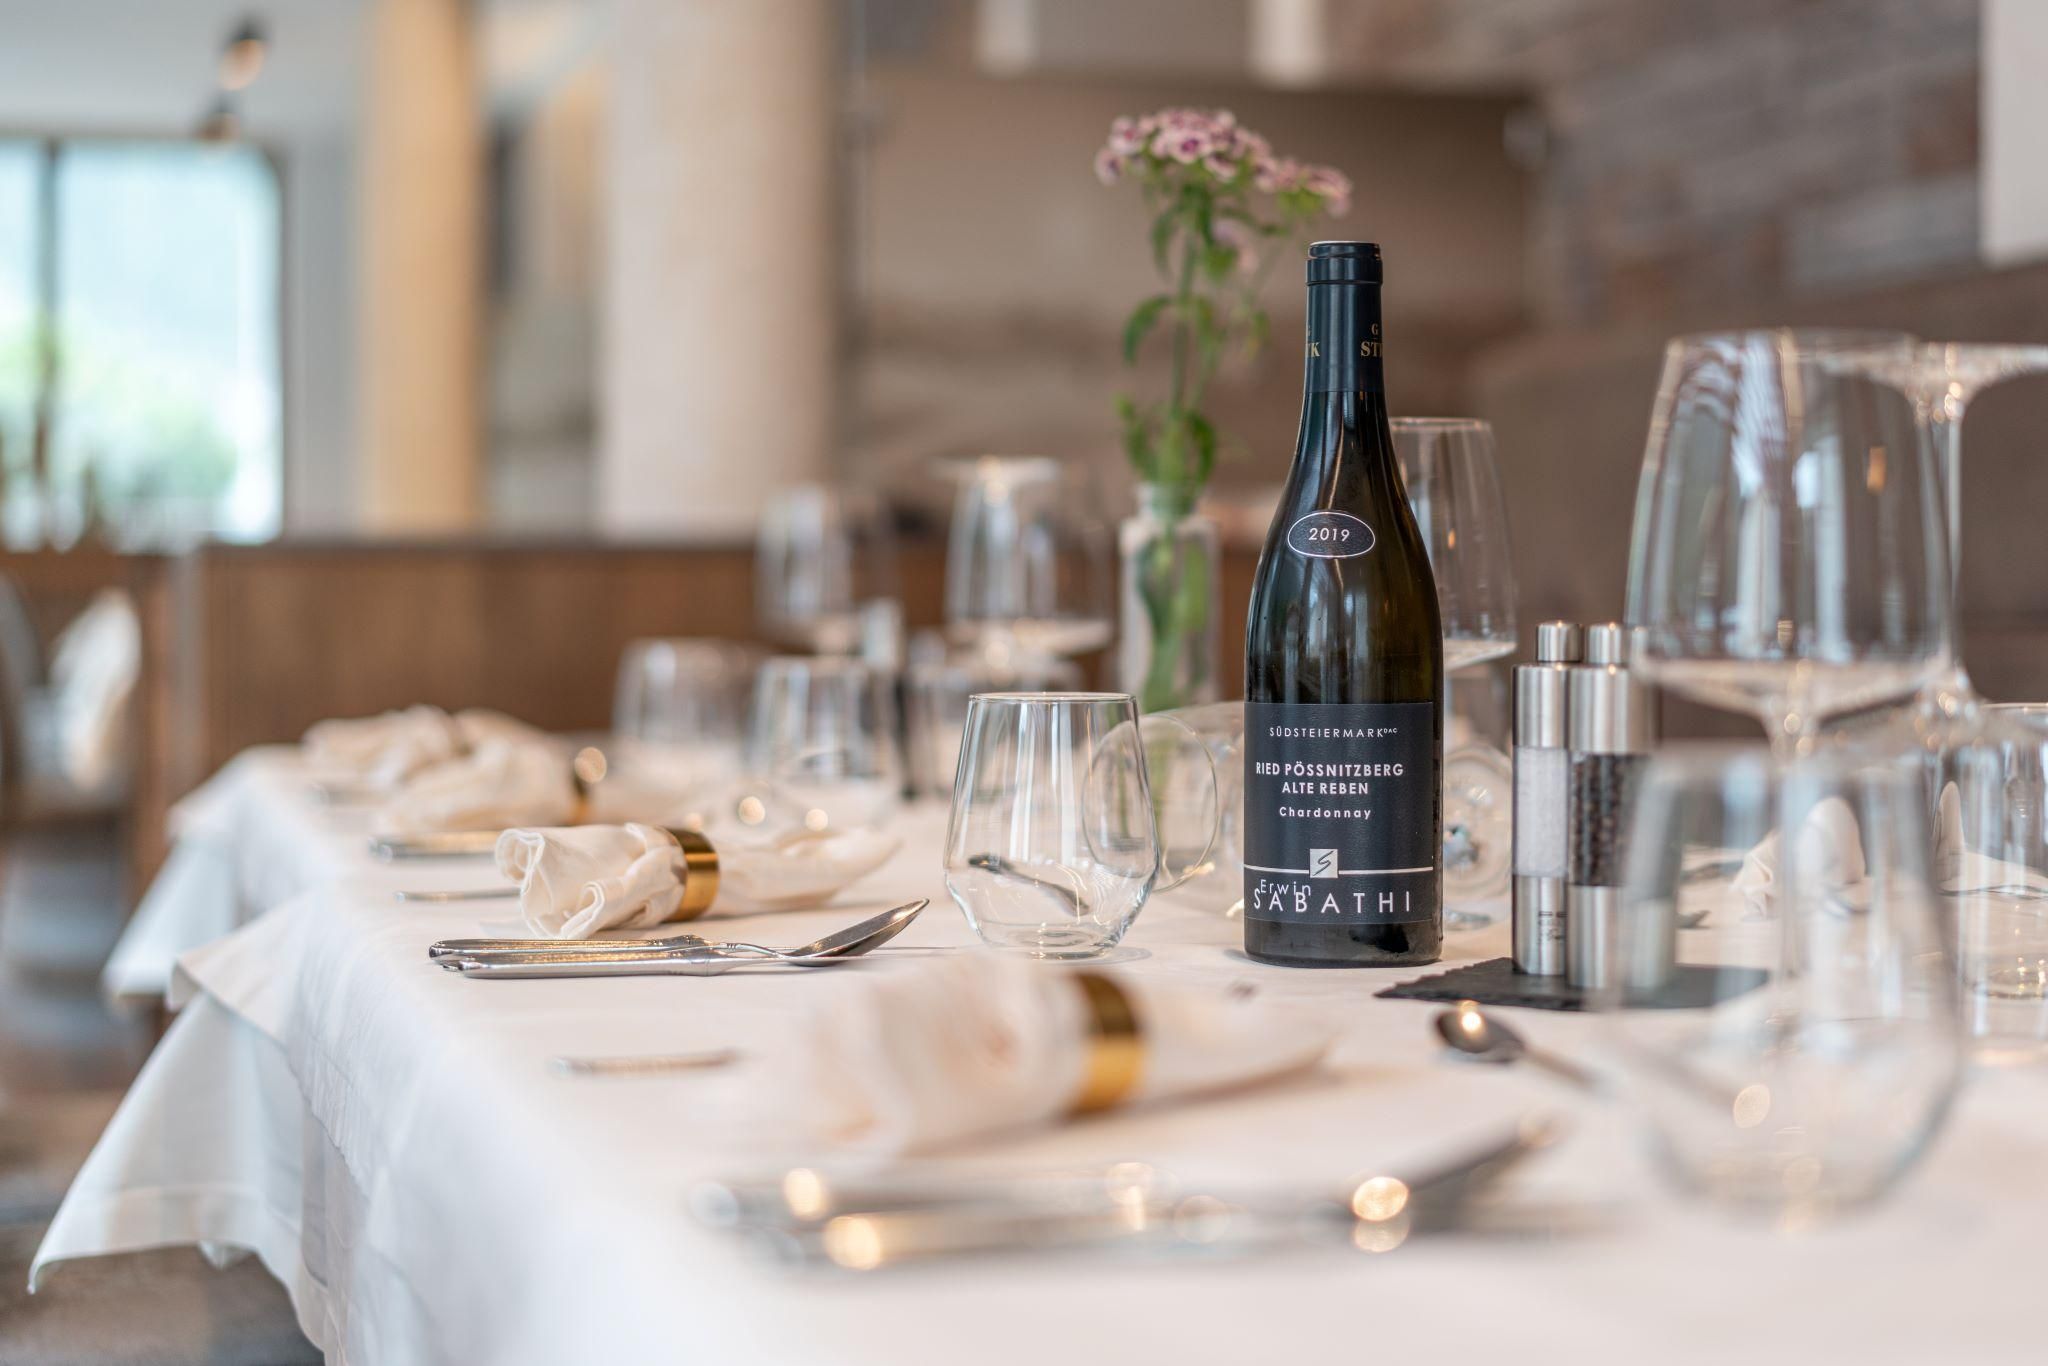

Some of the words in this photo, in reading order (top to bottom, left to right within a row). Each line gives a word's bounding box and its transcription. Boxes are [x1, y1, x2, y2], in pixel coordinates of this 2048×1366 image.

[1308, 527, 1350, 541] 2019
[1256, 762, 1280, 775] RIED
[1284, 761, 1404, 777] PÖSSNITZBERG
[1282, 782, 1314, 794] ALTE
[1319, 782, 1369, 795] REBEN
[1279, 806, 1371, 820] Chardonnay
[1260, 879, 1311, 896] Erwin
[1254, 888, 1410, 914] SABATHI
